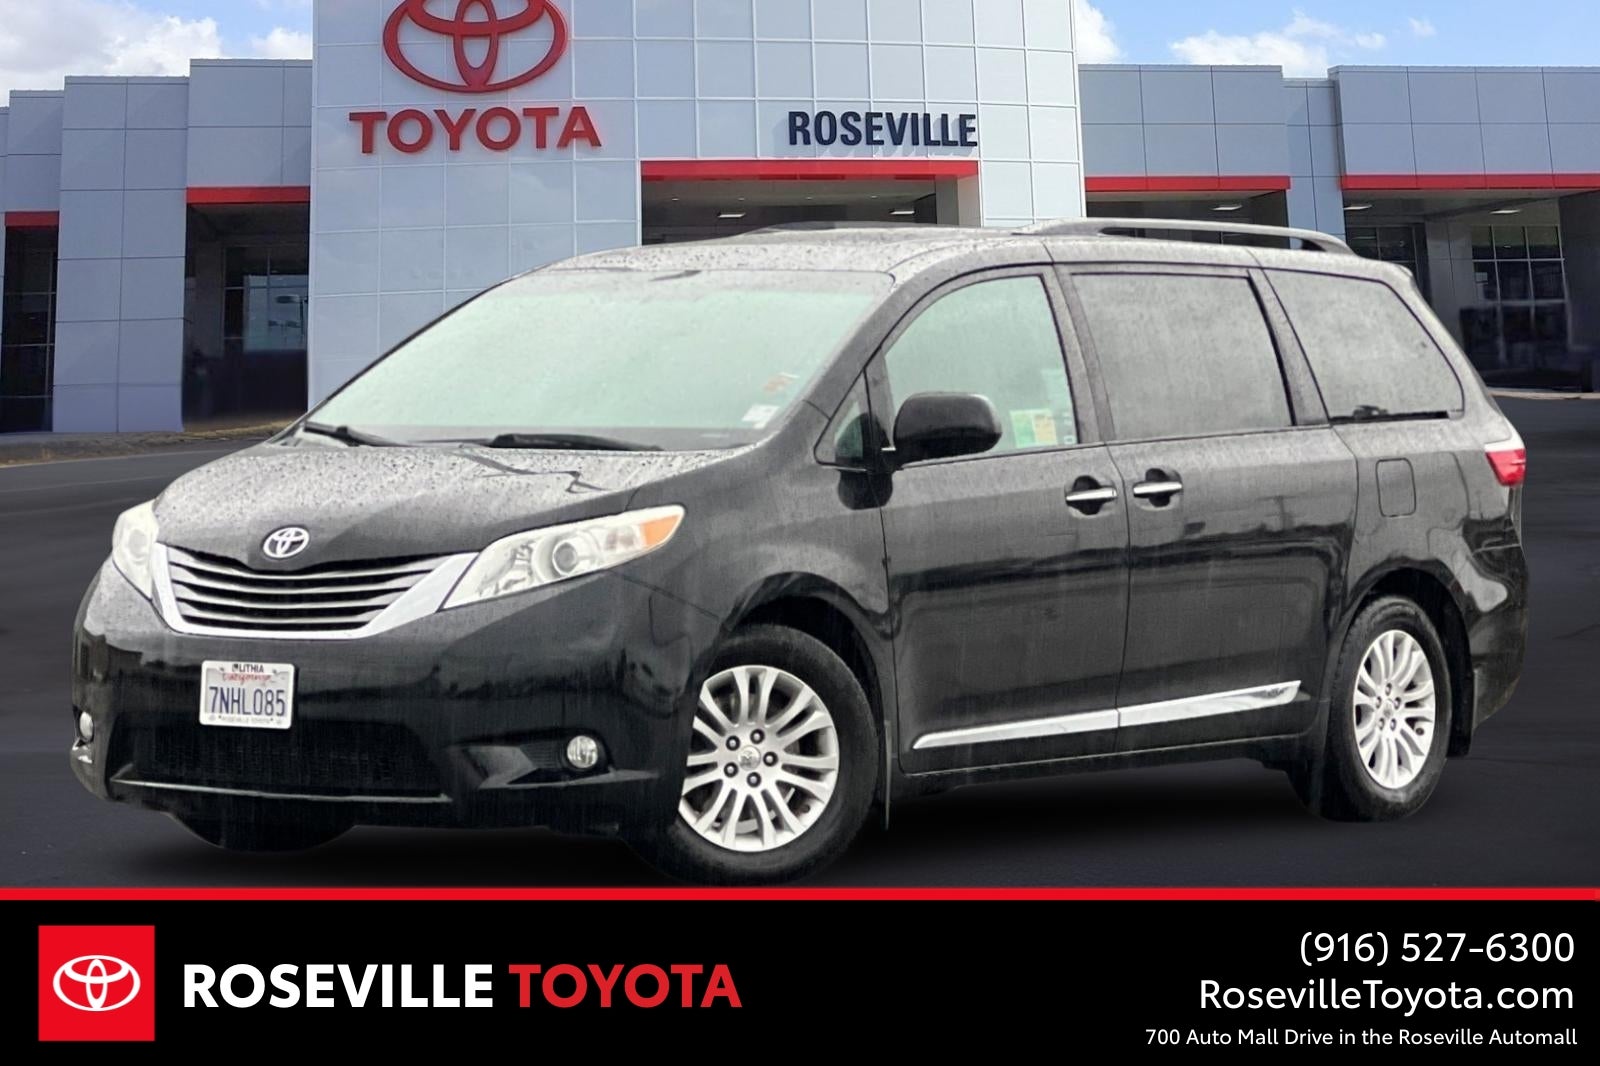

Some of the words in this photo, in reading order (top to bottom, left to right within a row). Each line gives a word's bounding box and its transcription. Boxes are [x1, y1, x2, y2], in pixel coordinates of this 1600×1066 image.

[349, 106, 602, 154] TOYOTA
[788, 110, 978, 147] ROSEVILLE
[209, 687, 286, 717] 7NHL085
